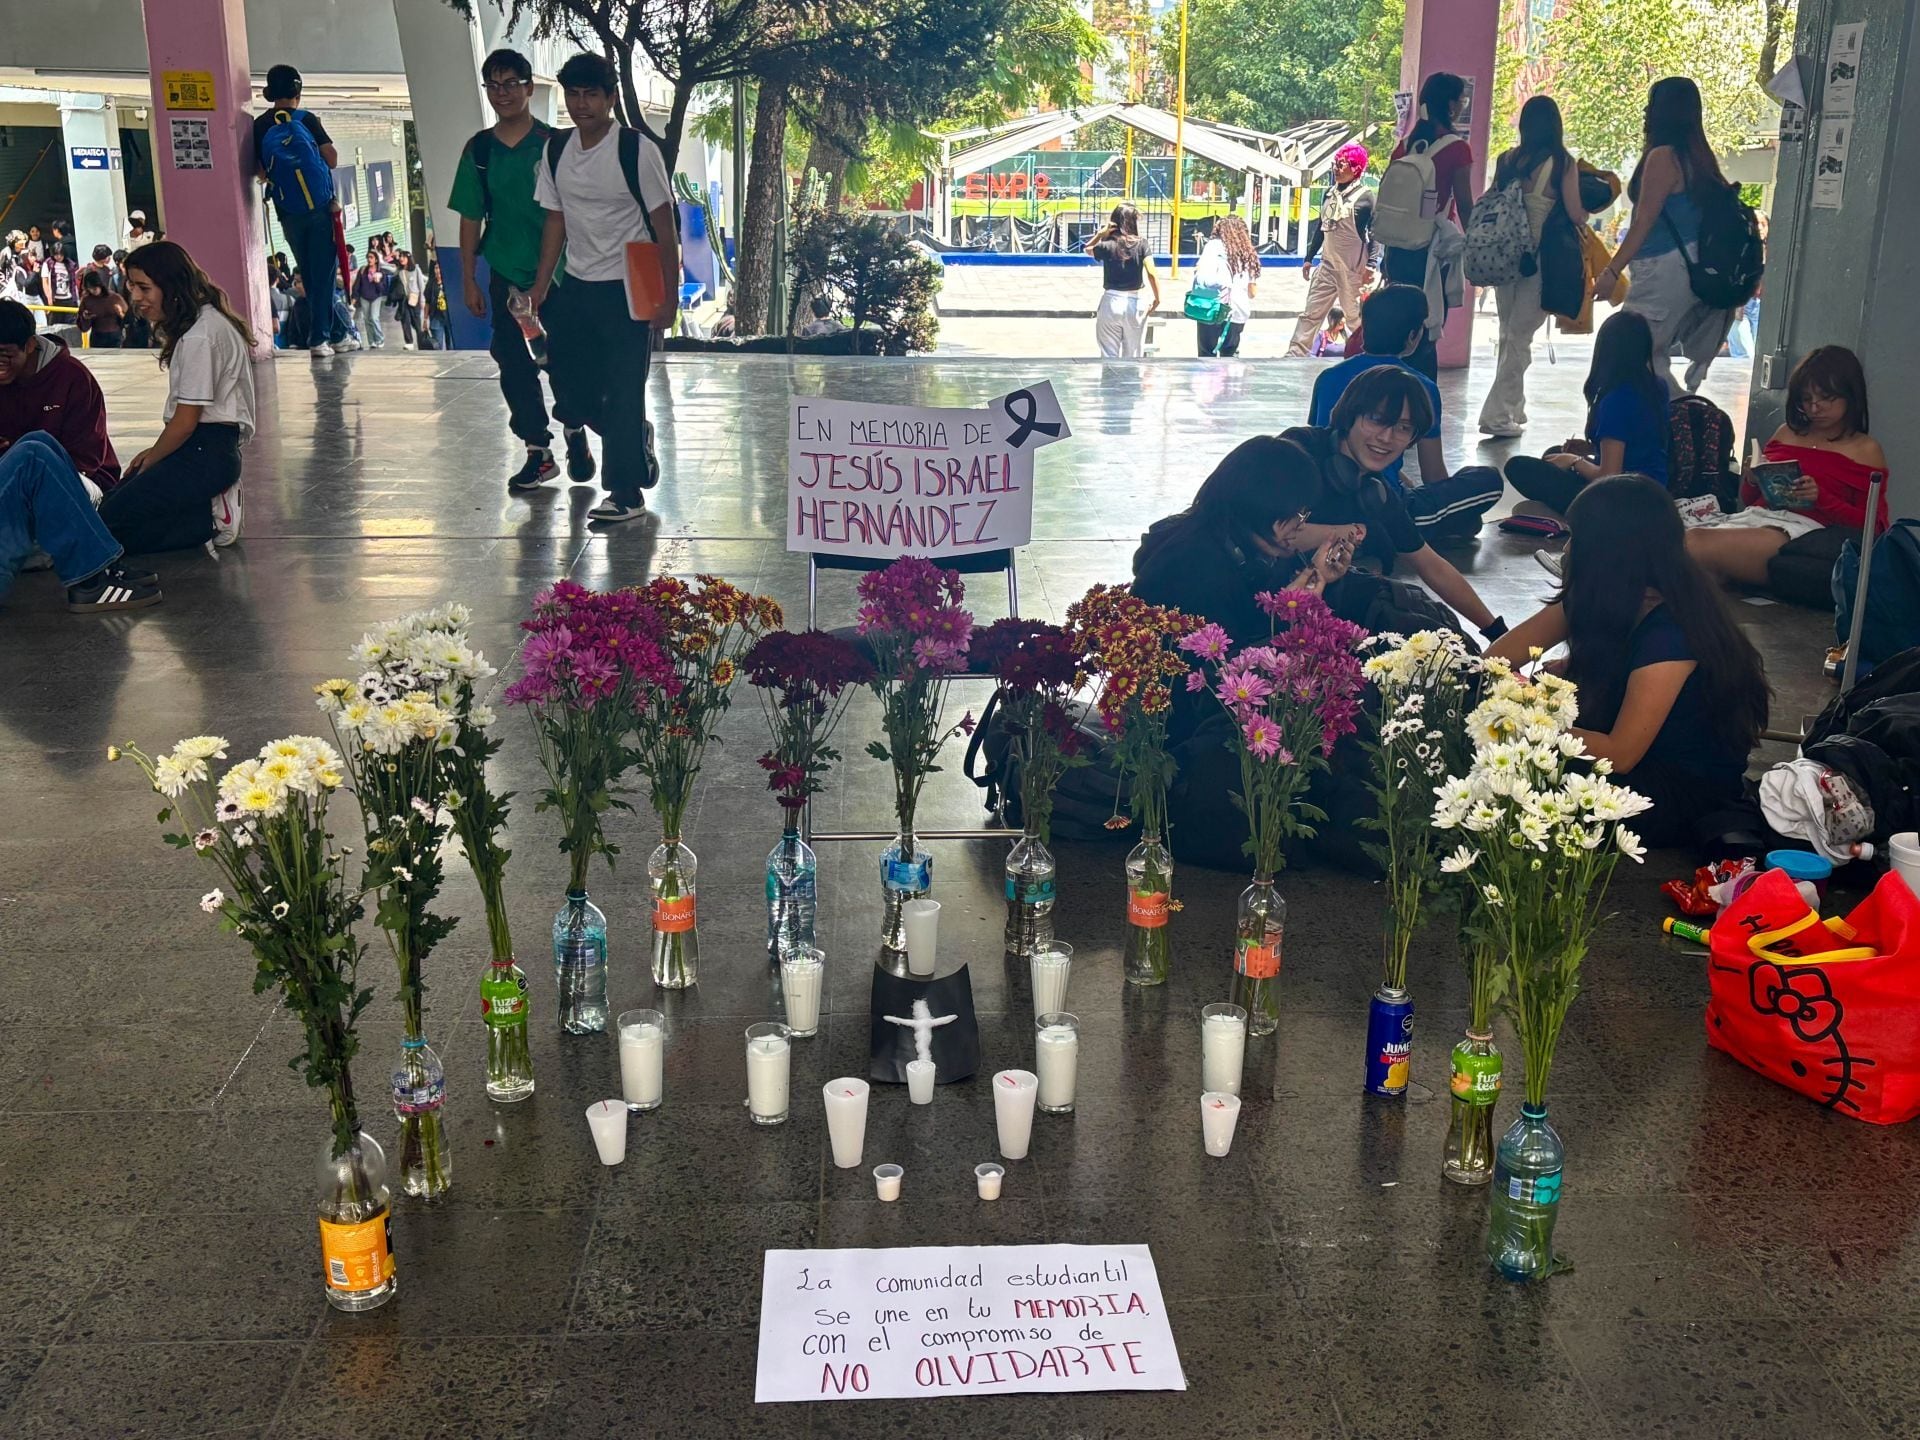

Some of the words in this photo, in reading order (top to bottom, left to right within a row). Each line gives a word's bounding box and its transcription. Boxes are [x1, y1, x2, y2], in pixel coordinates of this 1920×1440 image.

[73, 148, 105, 157] MEDIATECA
[850, 420, 948, 448] MEMORIA
[964, 423, 992, 445] DE
[798, 450, 903, 495] JESÚS
[913, 453, 1021, 497] ISRAEL
[797, 496, 999, 548] HERNÁNDEZ
[491, 995, 518, 1008] fuze
[1474, 1081, 1495, 1092] tea
[875, 1264, 984, 1293] comunidad
[1007, 1259, 1129, 1287] estudiantil
[875, 1308, 911, 1324] une
[925, 1303, 949, 1323] en
[967, 1296, 992, 1319] tu
[868, 1326, 891, 1353] el
[920, 1326, 1052, 1351] compromiso
[1078, 1323, 1103, 1342] de
[820, 1362, 870, 1395] NO
[915, 1341, 1147, 1388] OLVIDARTE
